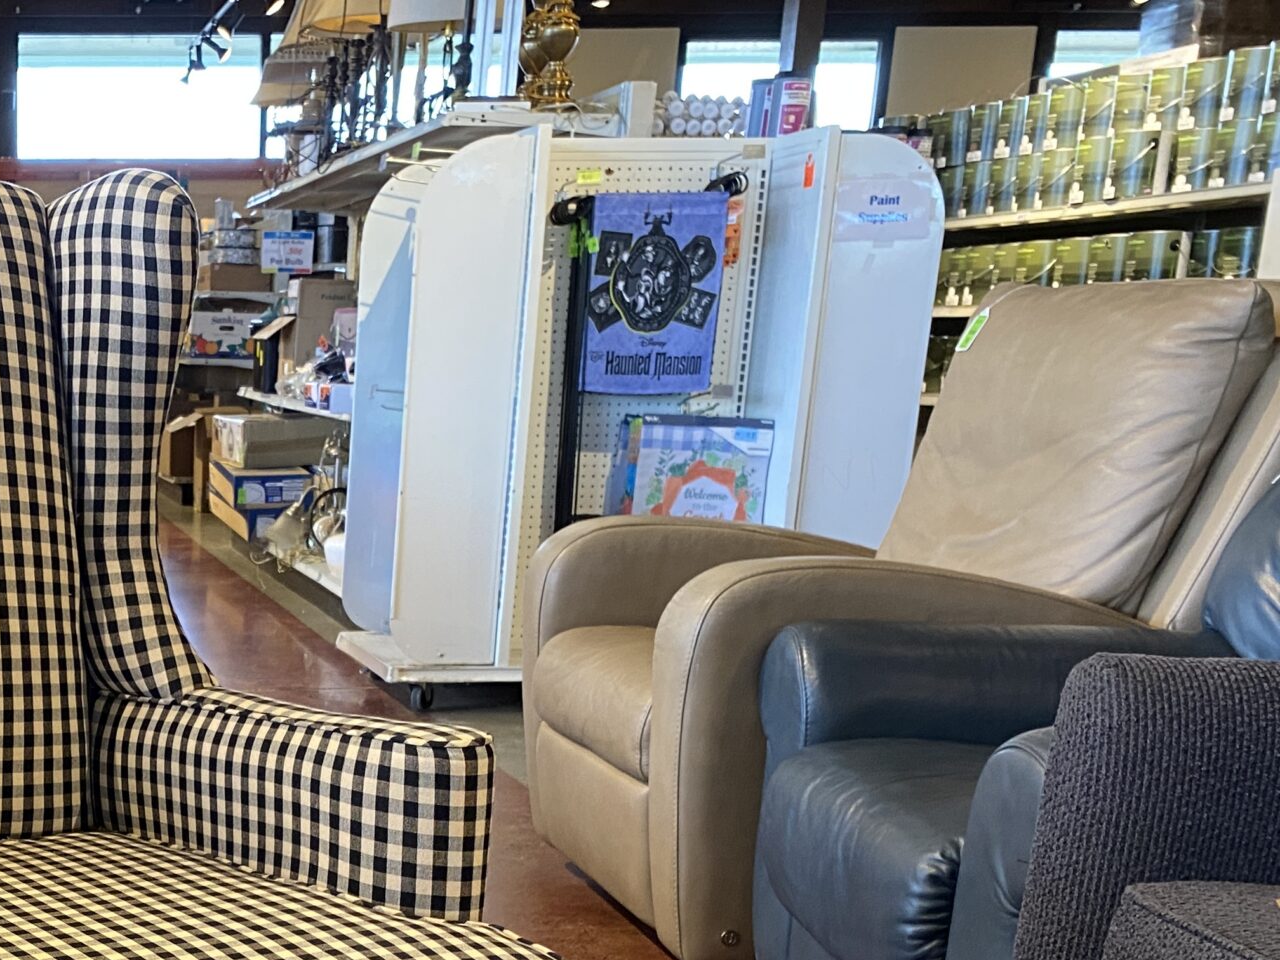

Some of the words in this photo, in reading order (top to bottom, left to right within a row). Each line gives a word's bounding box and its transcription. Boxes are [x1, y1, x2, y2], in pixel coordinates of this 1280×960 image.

[869, 194, 900, 206] Paint
[639, 336, 667, 349] Disney
[605, 350, 653, 376] Haunted
[651, 349, 702, 381] Mansion
[683, 487, 729, 500] Welcome
